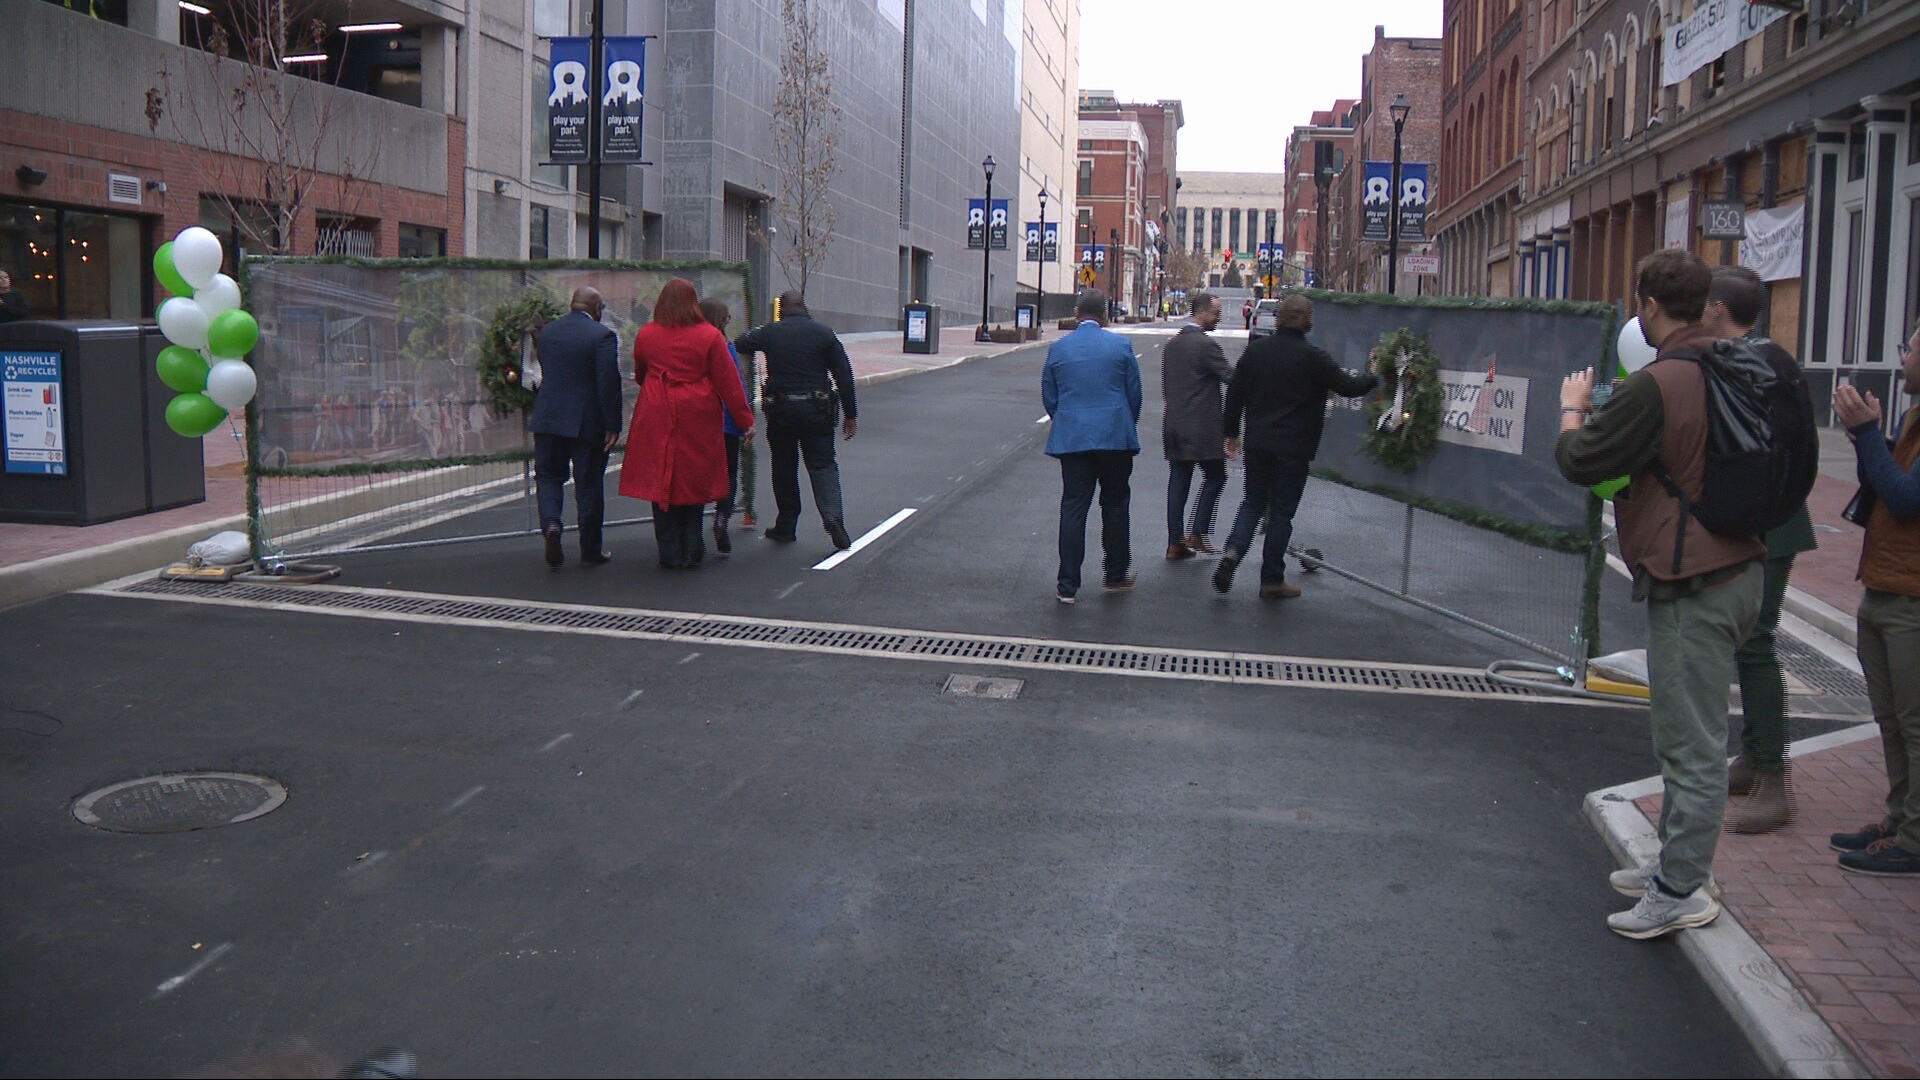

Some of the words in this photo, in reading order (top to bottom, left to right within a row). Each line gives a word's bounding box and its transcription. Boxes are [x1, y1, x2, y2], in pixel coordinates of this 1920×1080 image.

[553, 115, 569, 126] play
[569, 117, 586, 126] your
[607, 115, 622, 125] play
[622, 115, 639, 125] your
[560, 126, 578, 136] part.
[614, 126, 631, 136] part.
[1710, 210, 1740, 229] 160
[1407, 258, 1435, 266] LOADING
[4, 355, 56, 366] NASHVILLE
[17, 367, 57, 376] RECYCLES
